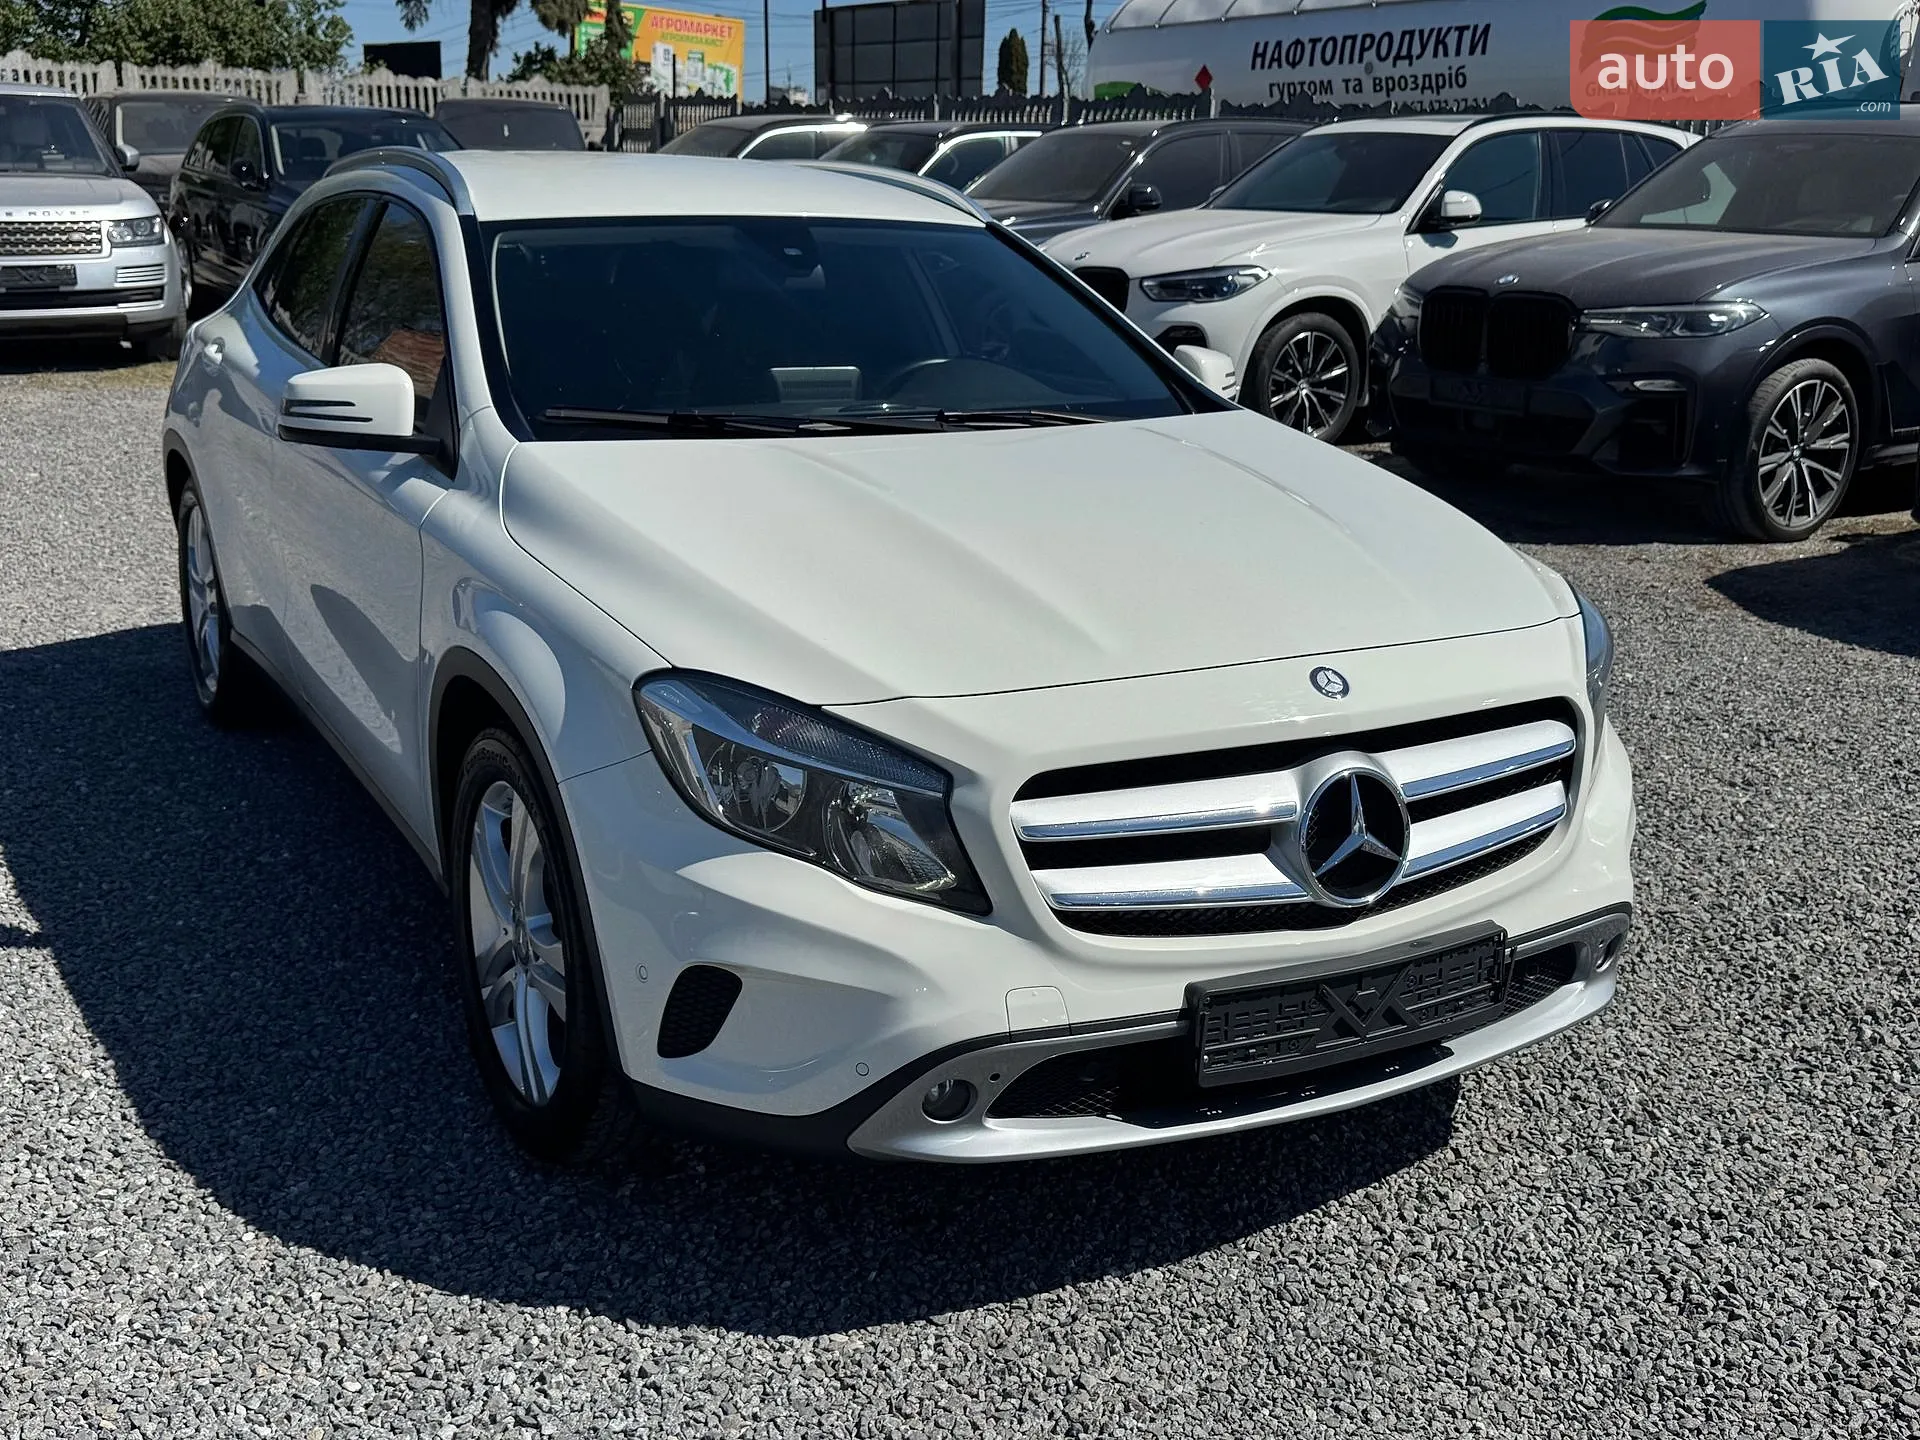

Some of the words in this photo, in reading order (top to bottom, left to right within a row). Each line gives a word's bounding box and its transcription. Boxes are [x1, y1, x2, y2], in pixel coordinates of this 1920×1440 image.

[651, 15, 733, 38] АГРОМАРКЕТ
[1251, 23, 1492, 71] НАФТОПРОДУКТИ
[1269, 78, 1333, 100] гуртом
[1342, 76, 1363, 95] та
[1373, 65, 1468, 98] вроздріб
